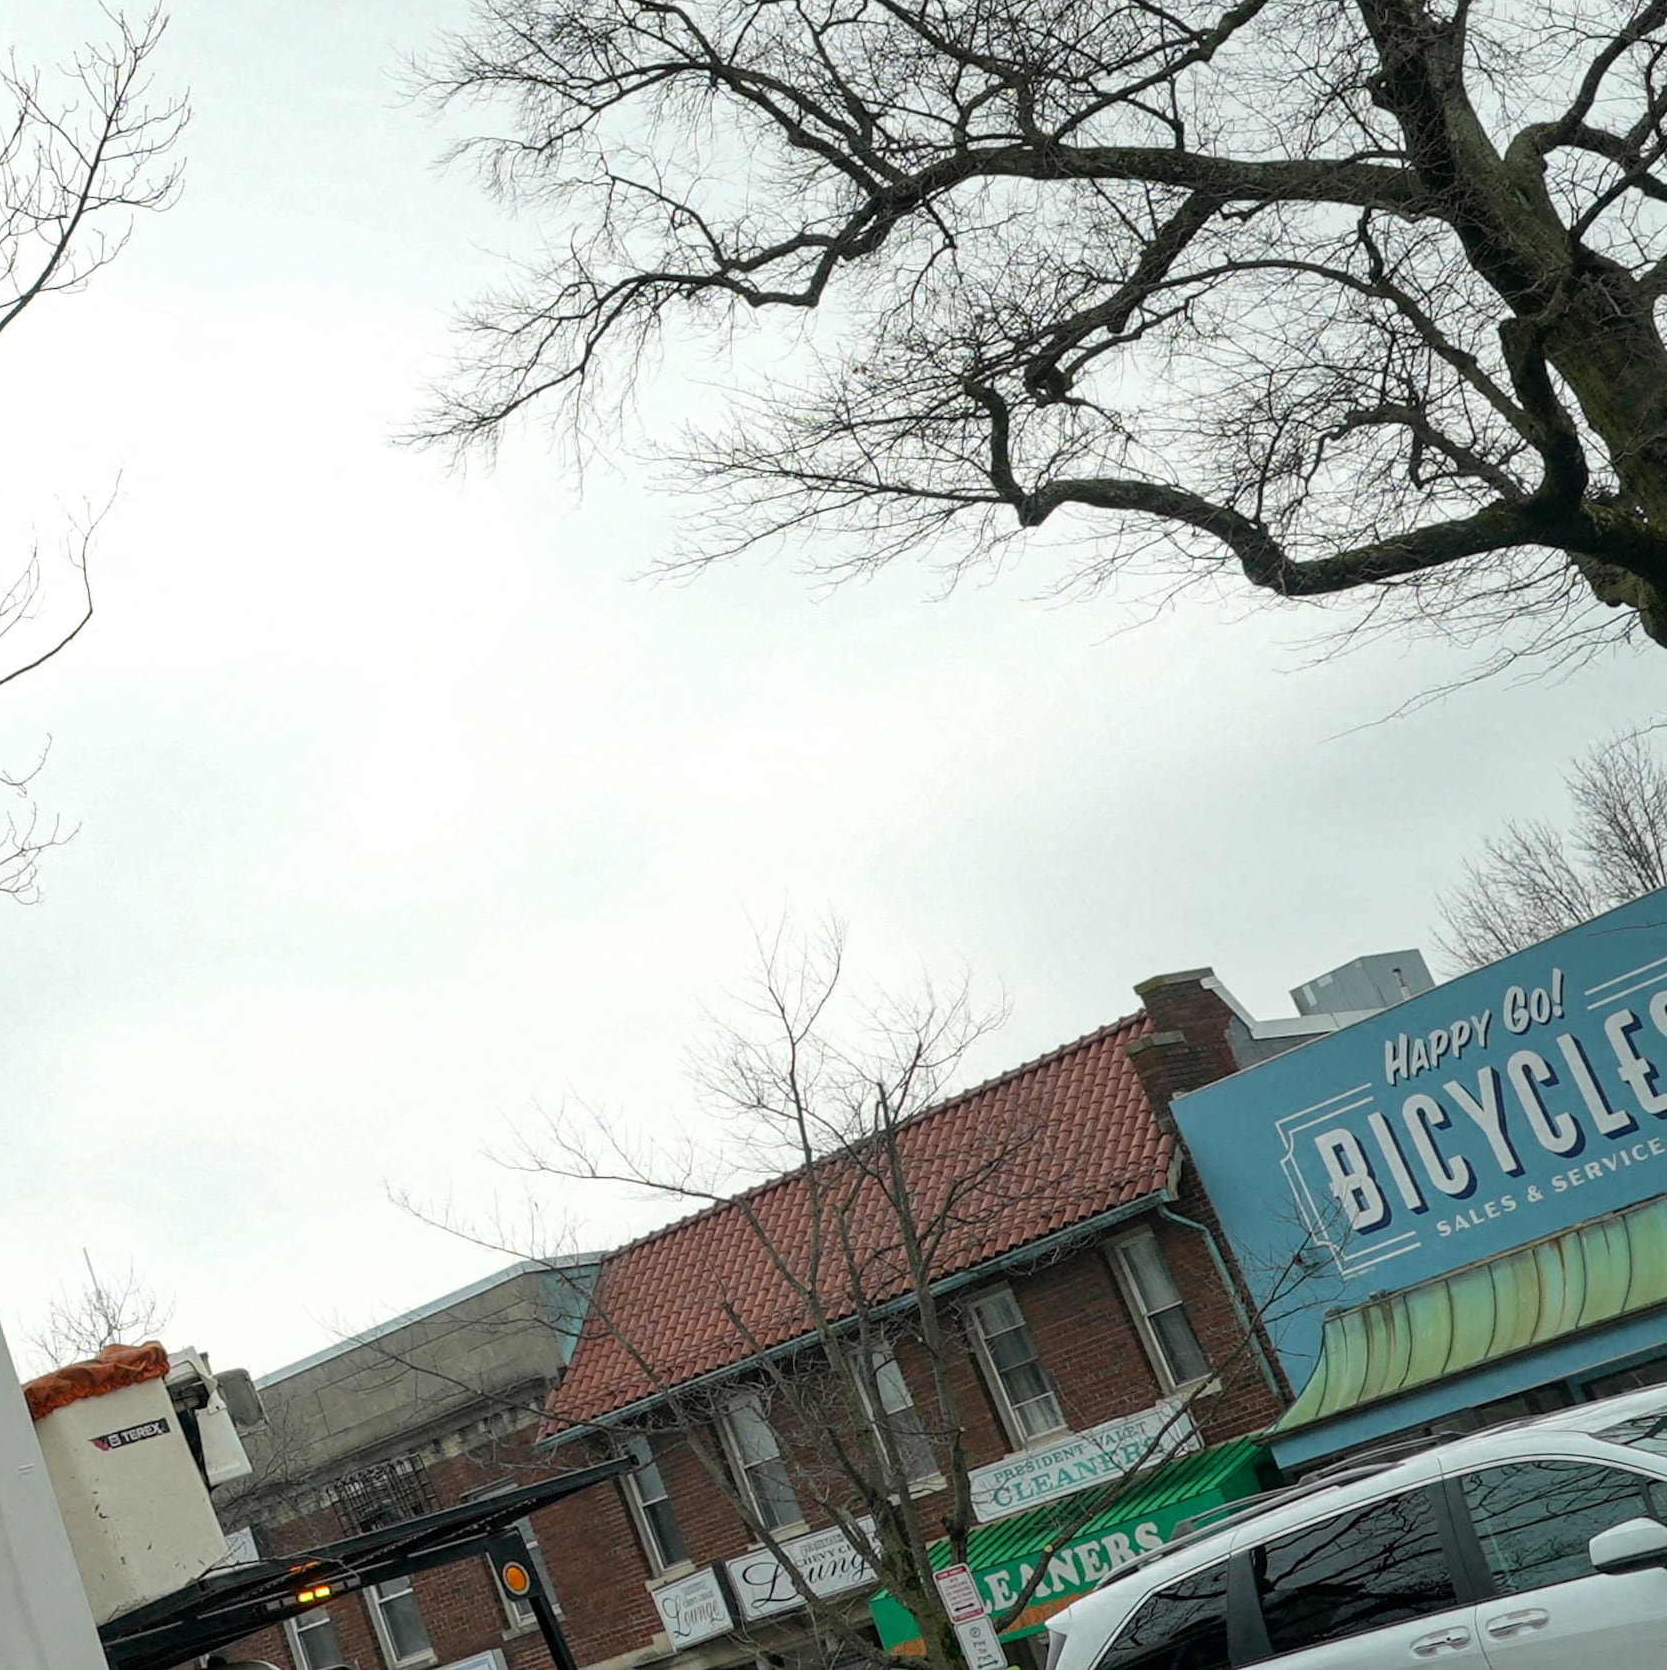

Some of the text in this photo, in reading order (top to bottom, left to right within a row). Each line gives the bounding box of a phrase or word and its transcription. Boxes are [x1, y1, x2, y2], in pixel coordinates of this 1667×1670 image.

[1384, 968, 1564, 1086] HAPPY GO!
[1314, 990, 1667, 1233] BICYCLE
[1436, 1137, 1666, 1237] SALES & SERVICE
[120, 1421, 163, 1443] TEREX
[993, 1421, 1149, 1482] PRESIDENT VALET
